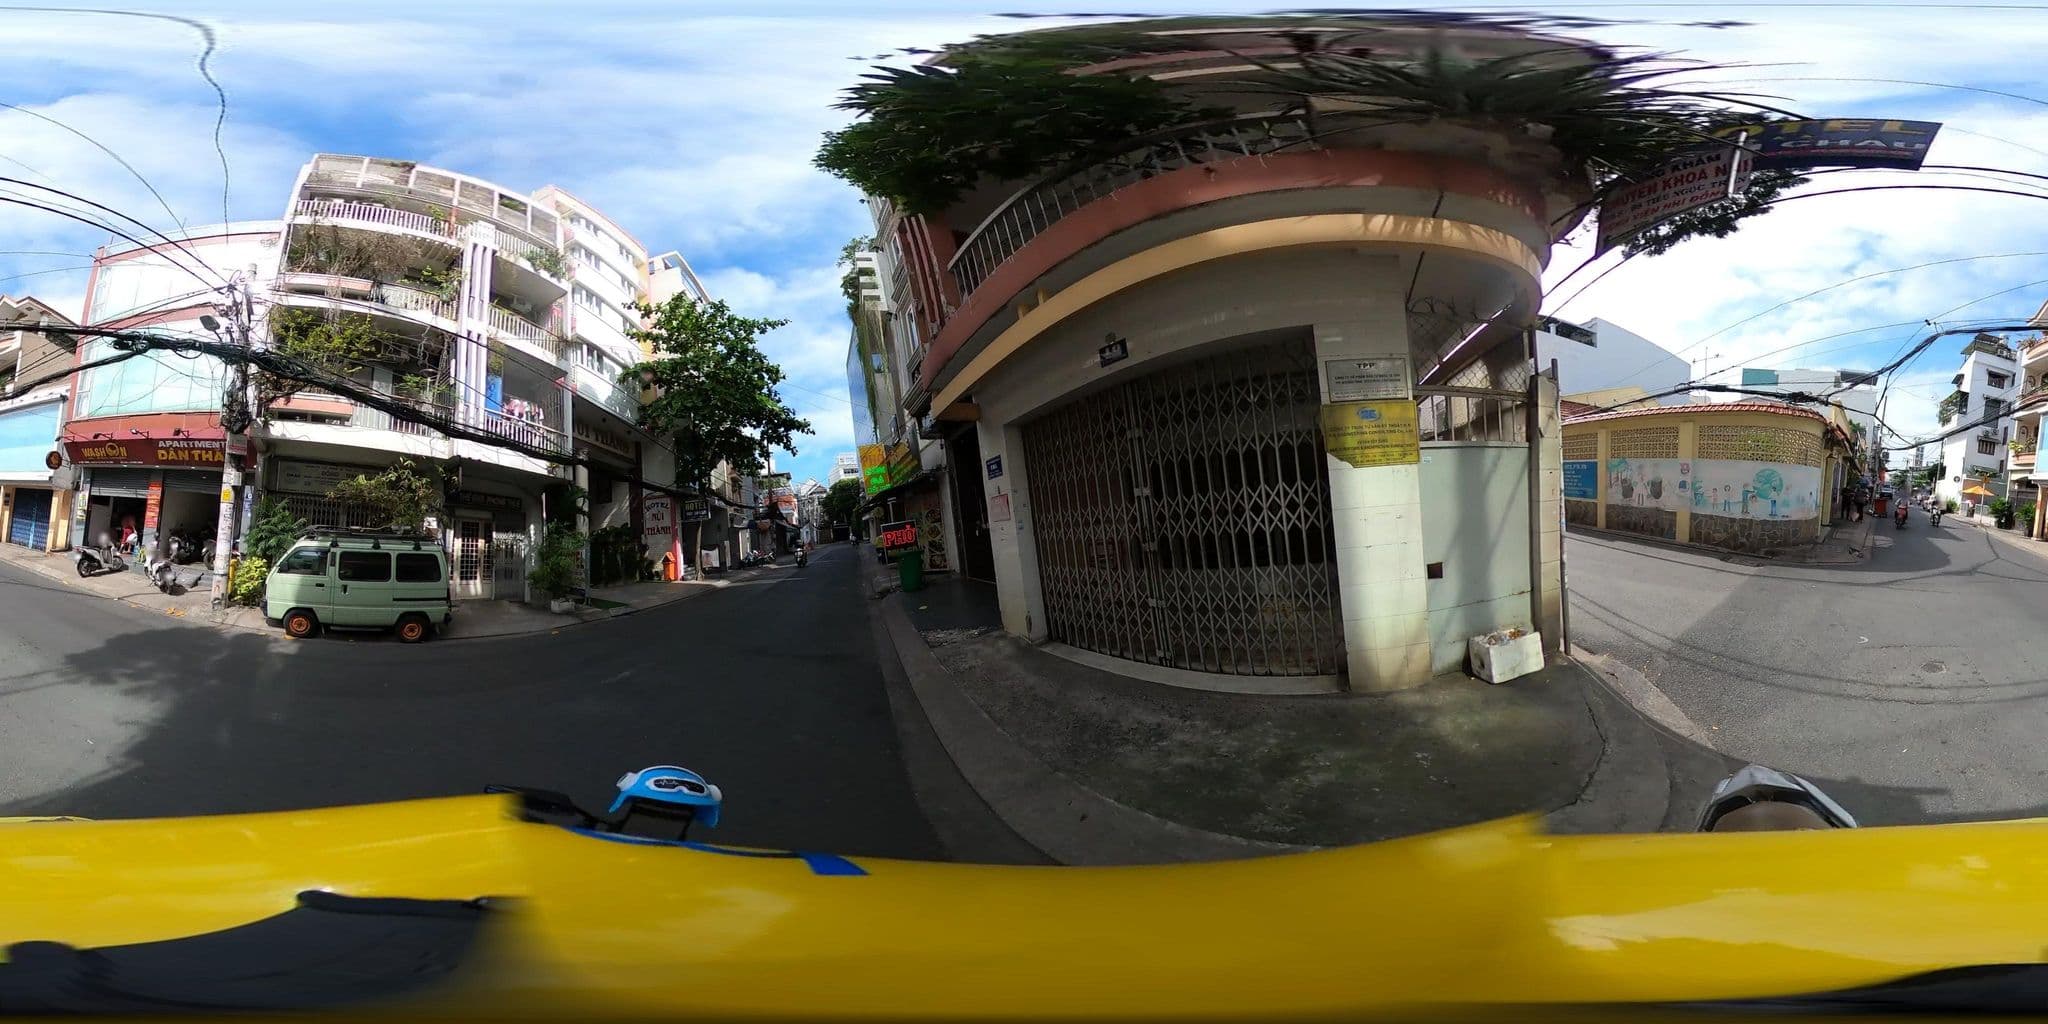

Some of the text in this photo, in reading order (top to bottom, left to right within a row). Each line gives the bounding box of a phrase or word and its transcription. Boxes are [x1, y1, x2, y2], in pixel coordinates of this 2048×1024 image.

[1661, 170, 1708, 190] KHOA
[158, 440, 226, 449] APARTMENT
[190, 450, 225, 462] THA
[645, 502, 670, 512] HOTEL
